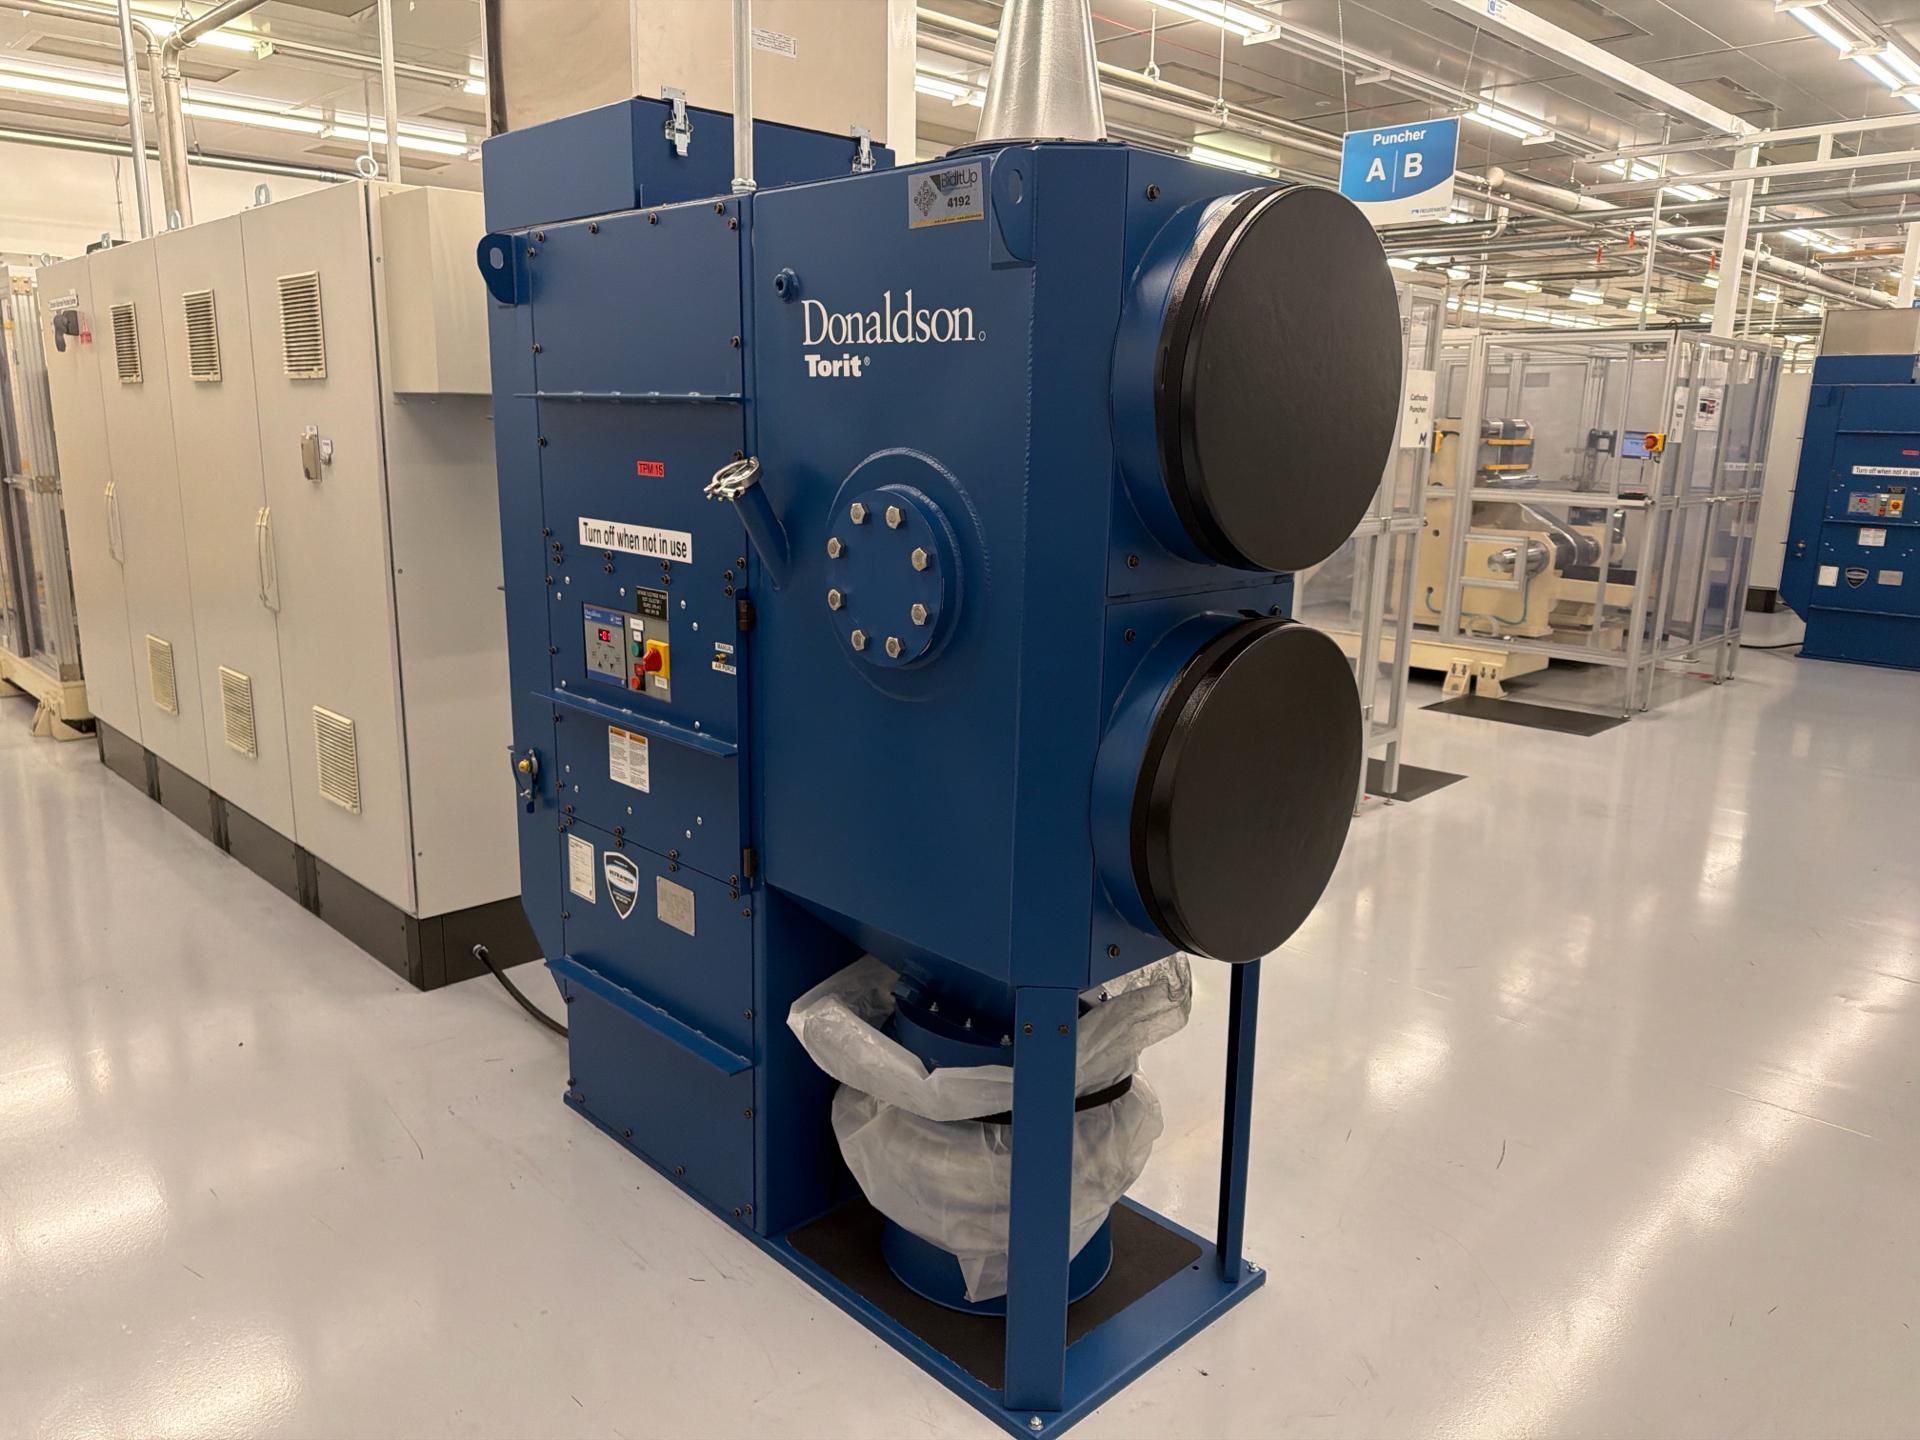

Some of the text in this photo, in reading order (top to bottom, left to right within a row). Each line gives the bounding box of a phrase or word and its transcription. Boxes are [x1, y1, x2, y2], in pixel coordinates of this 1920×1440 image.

[1372, 130, 1427, 146] Puncher
[1365, 152, 1423, 183] A B
[947, 194, 971, 209] 4192
[1856, 466, 1868, 474] Turn
[583, 521, 688, 559] Turn off when not in use
